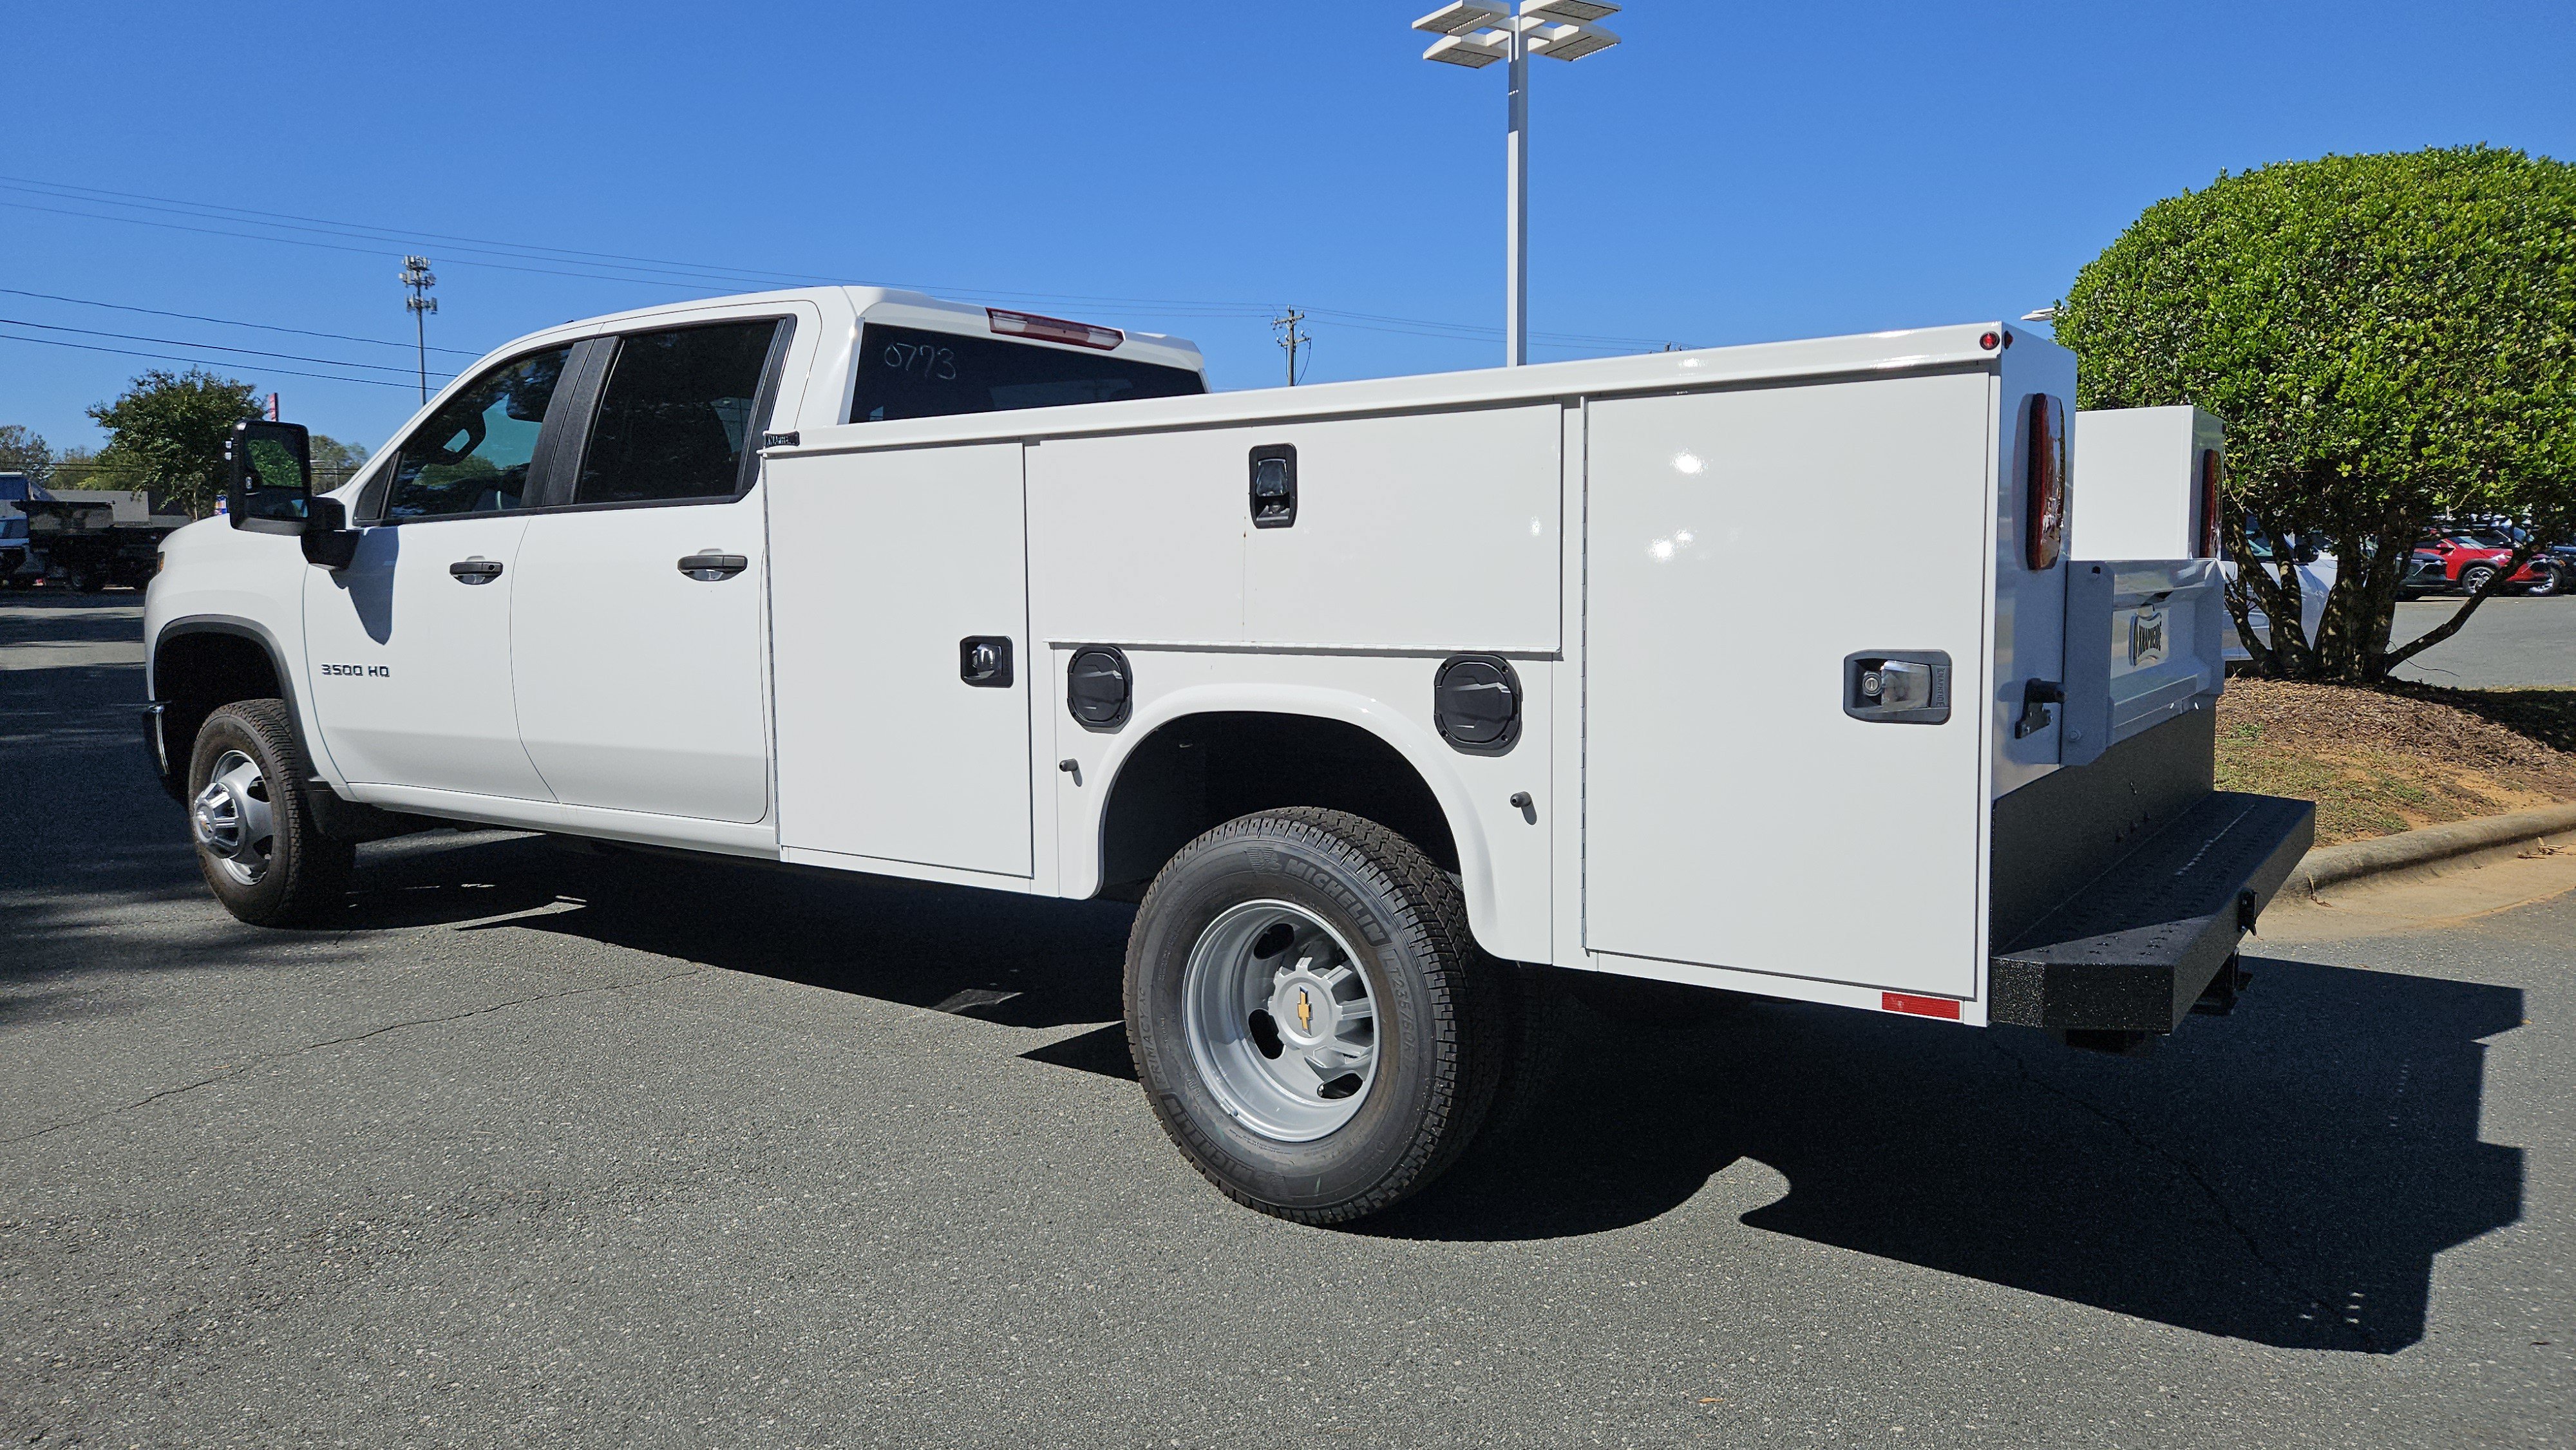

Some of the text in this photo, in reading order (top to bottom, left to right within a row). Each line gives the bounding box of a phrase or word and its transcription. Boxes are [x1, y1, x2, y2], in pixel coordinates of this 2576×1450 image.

[884, 342, 956, 380] 0773
[765, 433, 798, 447] KNAPHE
[321, 664, 389, 677] 3500 HD
[1285, 858, 1387, 943] MICHELIN
